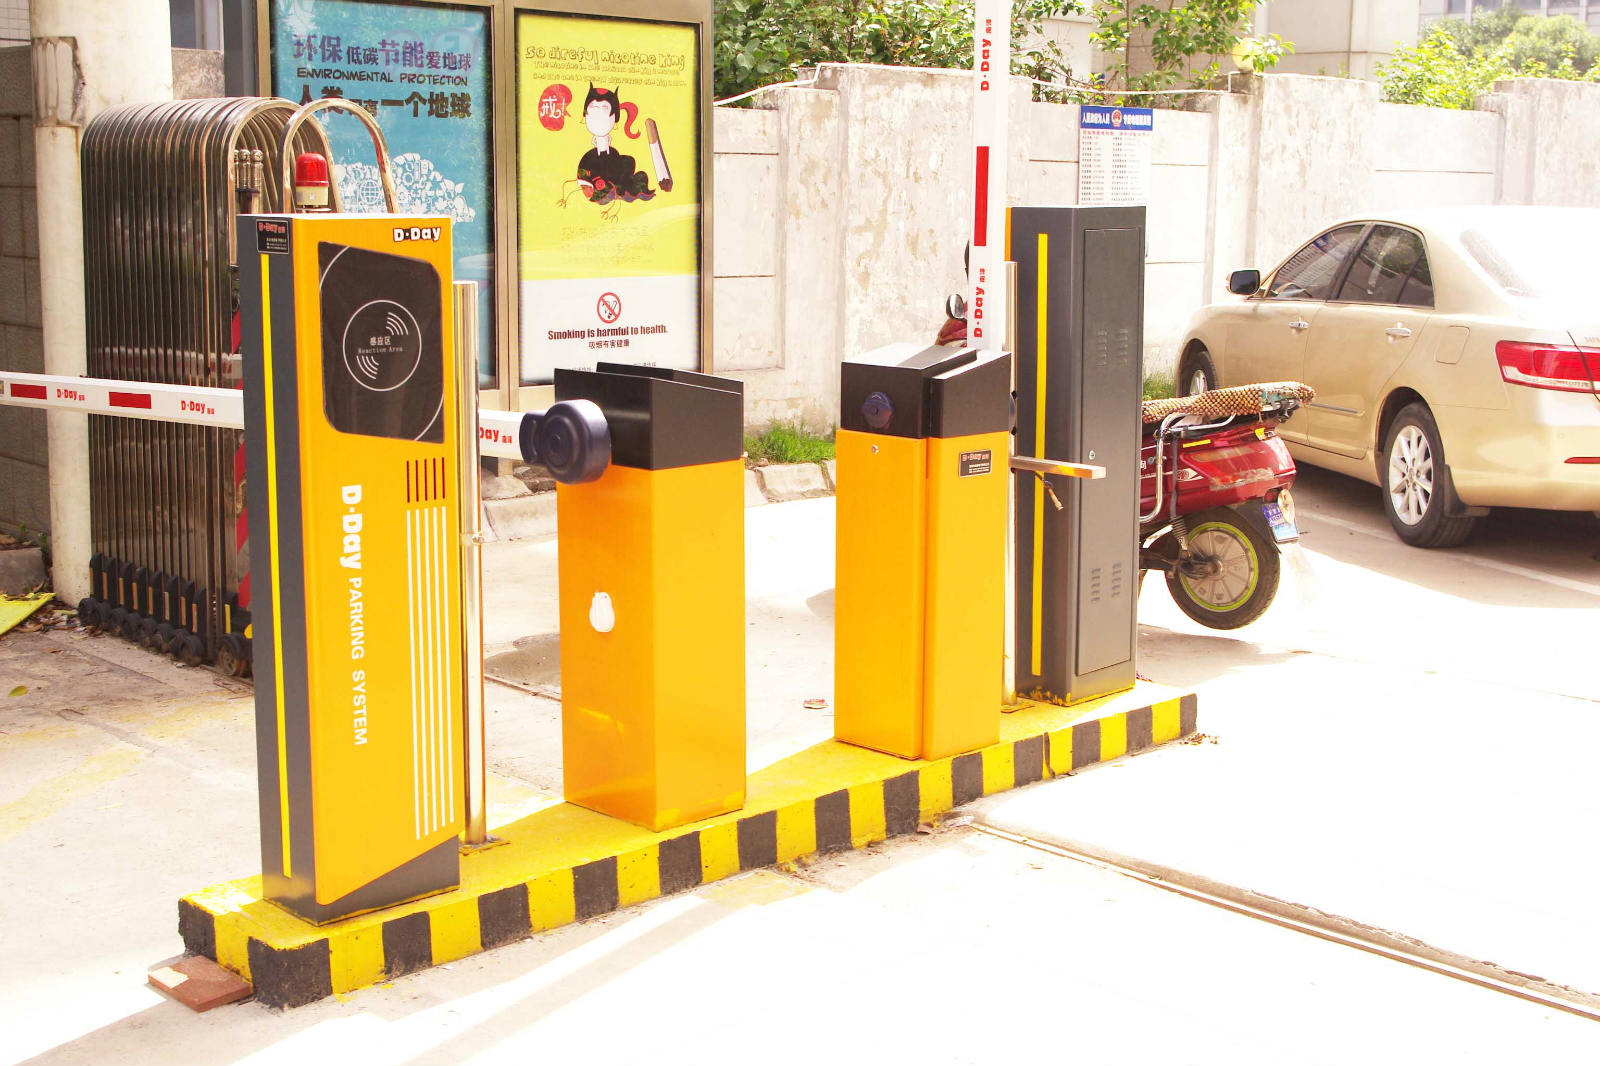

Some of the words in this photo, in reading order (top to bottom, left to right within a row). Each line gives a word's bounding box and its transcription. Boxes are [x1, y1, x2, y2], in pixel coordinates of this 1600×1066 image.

[293, 34, 472, 71] 环保低碳节能爱地球
[525, 45, 546, 59] So
[601, 50, 657, 66] nicotine
[297, 67, 394, 83] ENVIRONMENTAL
[400, 73, 468, 87] PROTECTION
[369, 335, 391, 346] 感应区
[548, 329, 586, 341] Smoking
[587, 328, 595, 338] is
[596, 326, 629, 338] harmful
[630, 326, 639, 336] to
[588, 338, 630, 350] 吸烟有害健康
[348, 577, 365, 660] PARKING
[352, 669, 368, 746] SYSTEM
